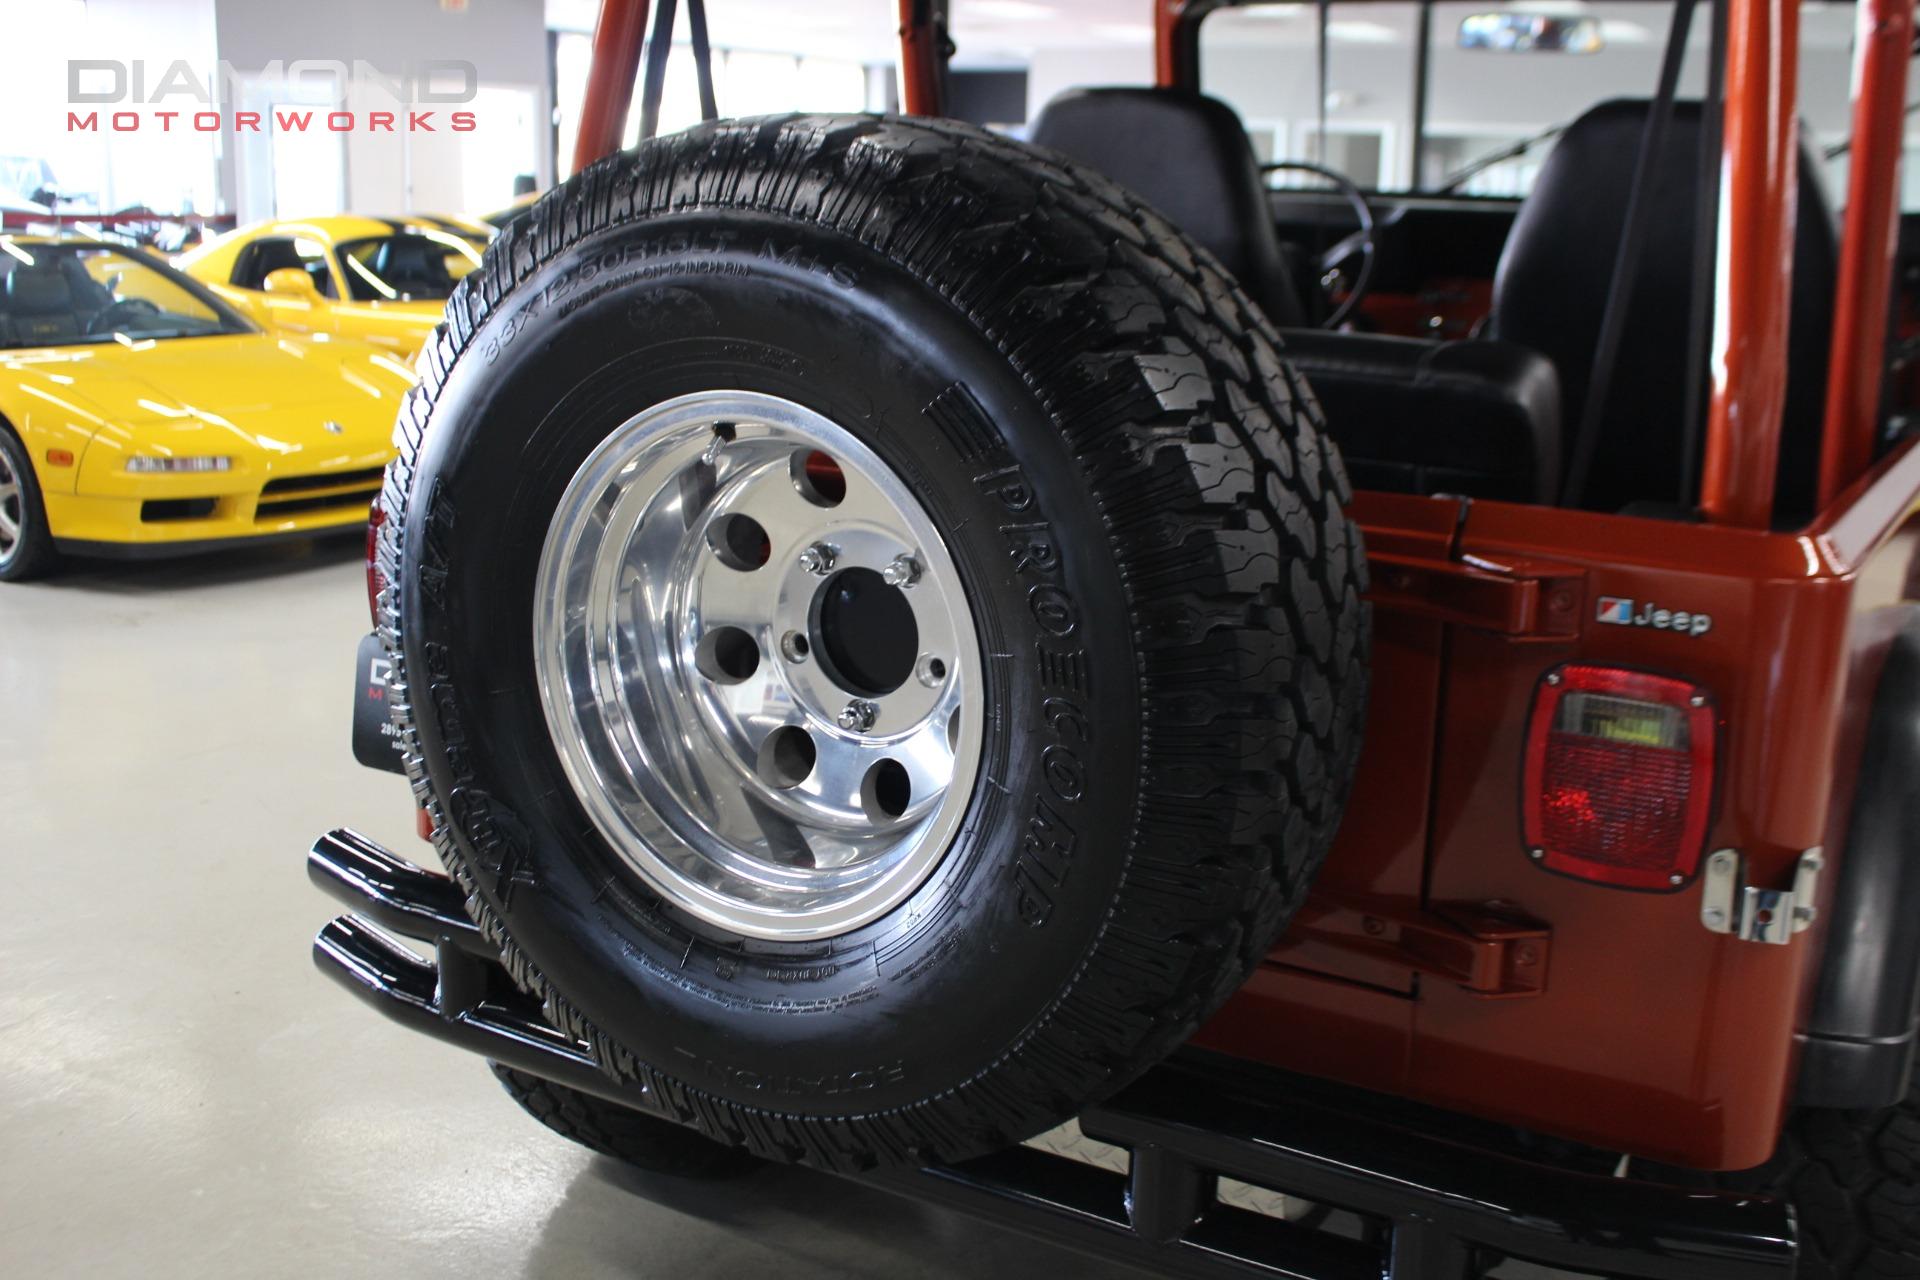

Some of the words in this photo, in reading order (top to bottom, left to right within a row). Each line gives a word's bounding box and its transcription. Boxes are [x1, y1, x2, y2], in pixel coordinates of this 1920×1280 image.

[603, 270, 640, 293] ONLY
[684, 259, 719, 273] INCH
[724, 260, 751, 276] RIM
[1634, 602, 1712, 636] Jeep
